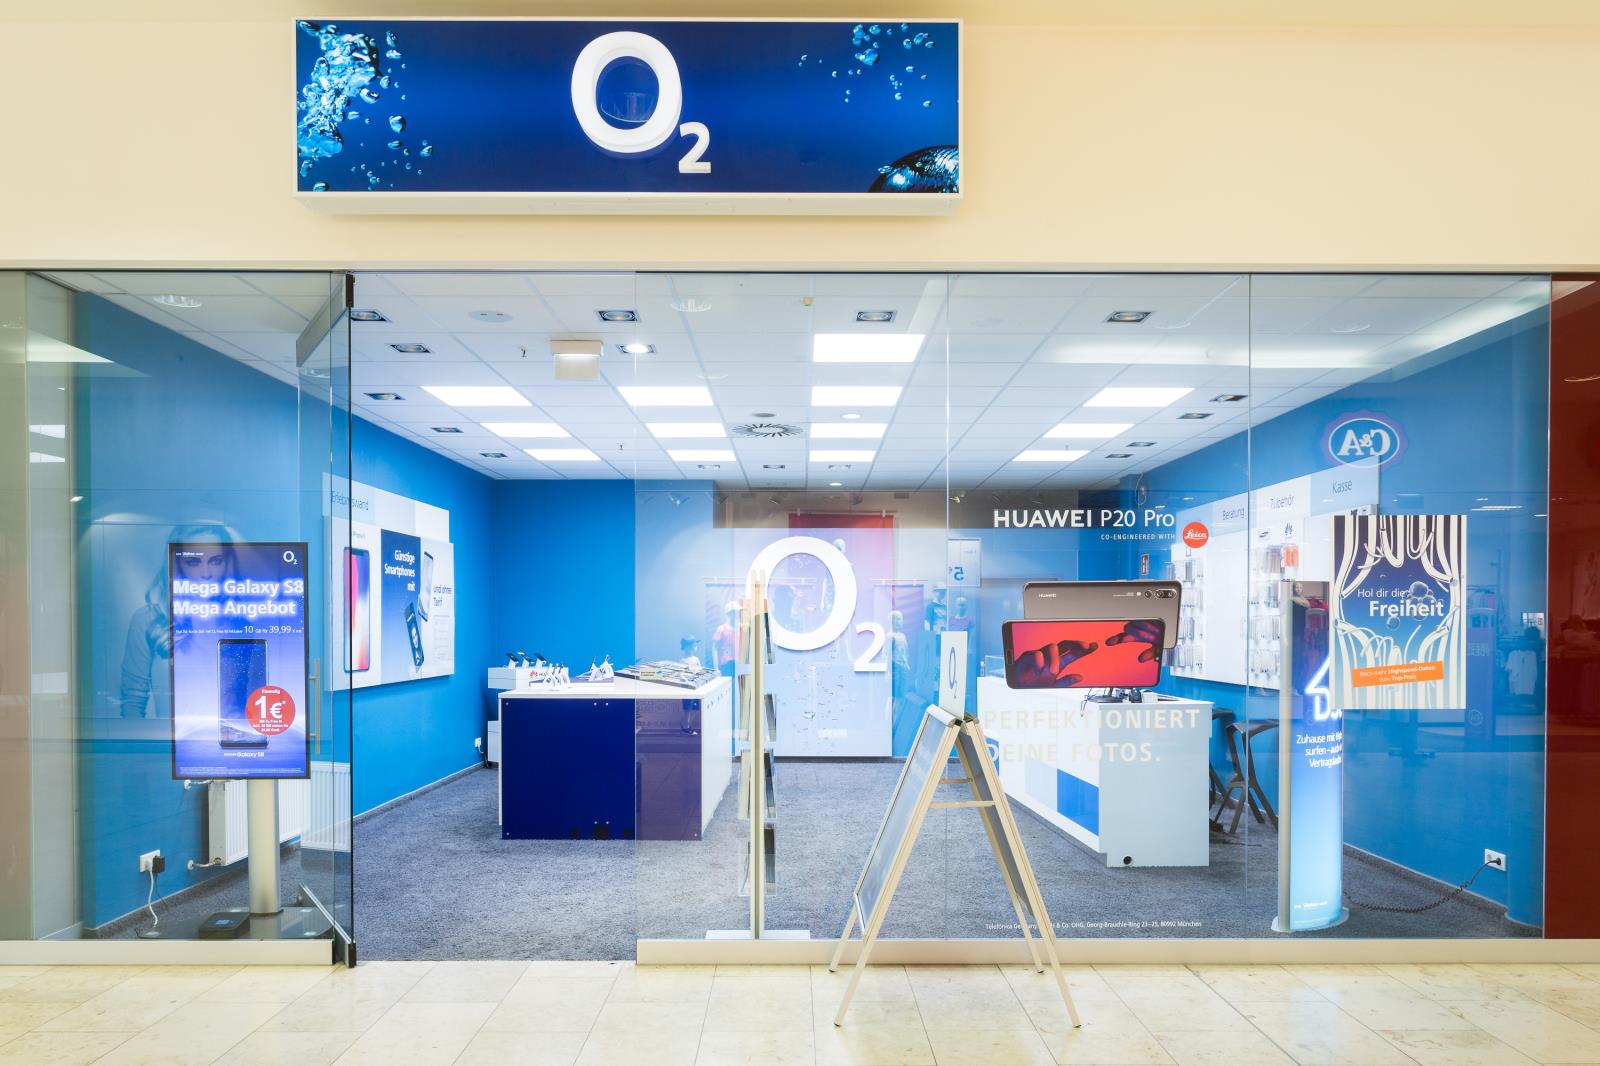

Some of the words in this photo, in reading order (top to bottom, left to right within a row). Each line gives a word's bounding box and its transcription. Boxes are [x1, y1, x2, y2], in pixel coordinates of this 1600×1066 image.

[1332, 480, 1353, 494] Kasse
[993, 509, 1092, 528] HUAWEI
[1101, 509, 1136, 528] P20
[1145, 509, 1174, 528] Pro
[1222, 507, 1245, 520] Beratung
[1101, 533, 1156, 541] CO-ENGINEERED
[1158, 533, 1175, 541] WITH
[1184, 529, 1207, 541] Leica
[384, 563, 416, 578] Smartphones
[173, 580, 219, 597] Mega
[224, 579, 280, 598] Galaxy
[283, 579, 304, 594] S8
[1357, 588, 1373, 598] Hol
[1376, 588, 1389, 598] dir
[1391, 588, 1405, 598] die
[173, 601, 219, 618] Mega
[224, 600, 297, 618] Angebot
[1369, 600, 1444, 617] Freiheit
[244, 625, 254, 634] 10
[269, 625, 292, 635] 39,99
[984, 709, 1200, 729] PERFEKTIONIERT
[1296, 734, 1326, 744] Zuhause
[985, 743, 1058, 763] DEINE
[1071, 742, 1161, 763] FOTOS.
